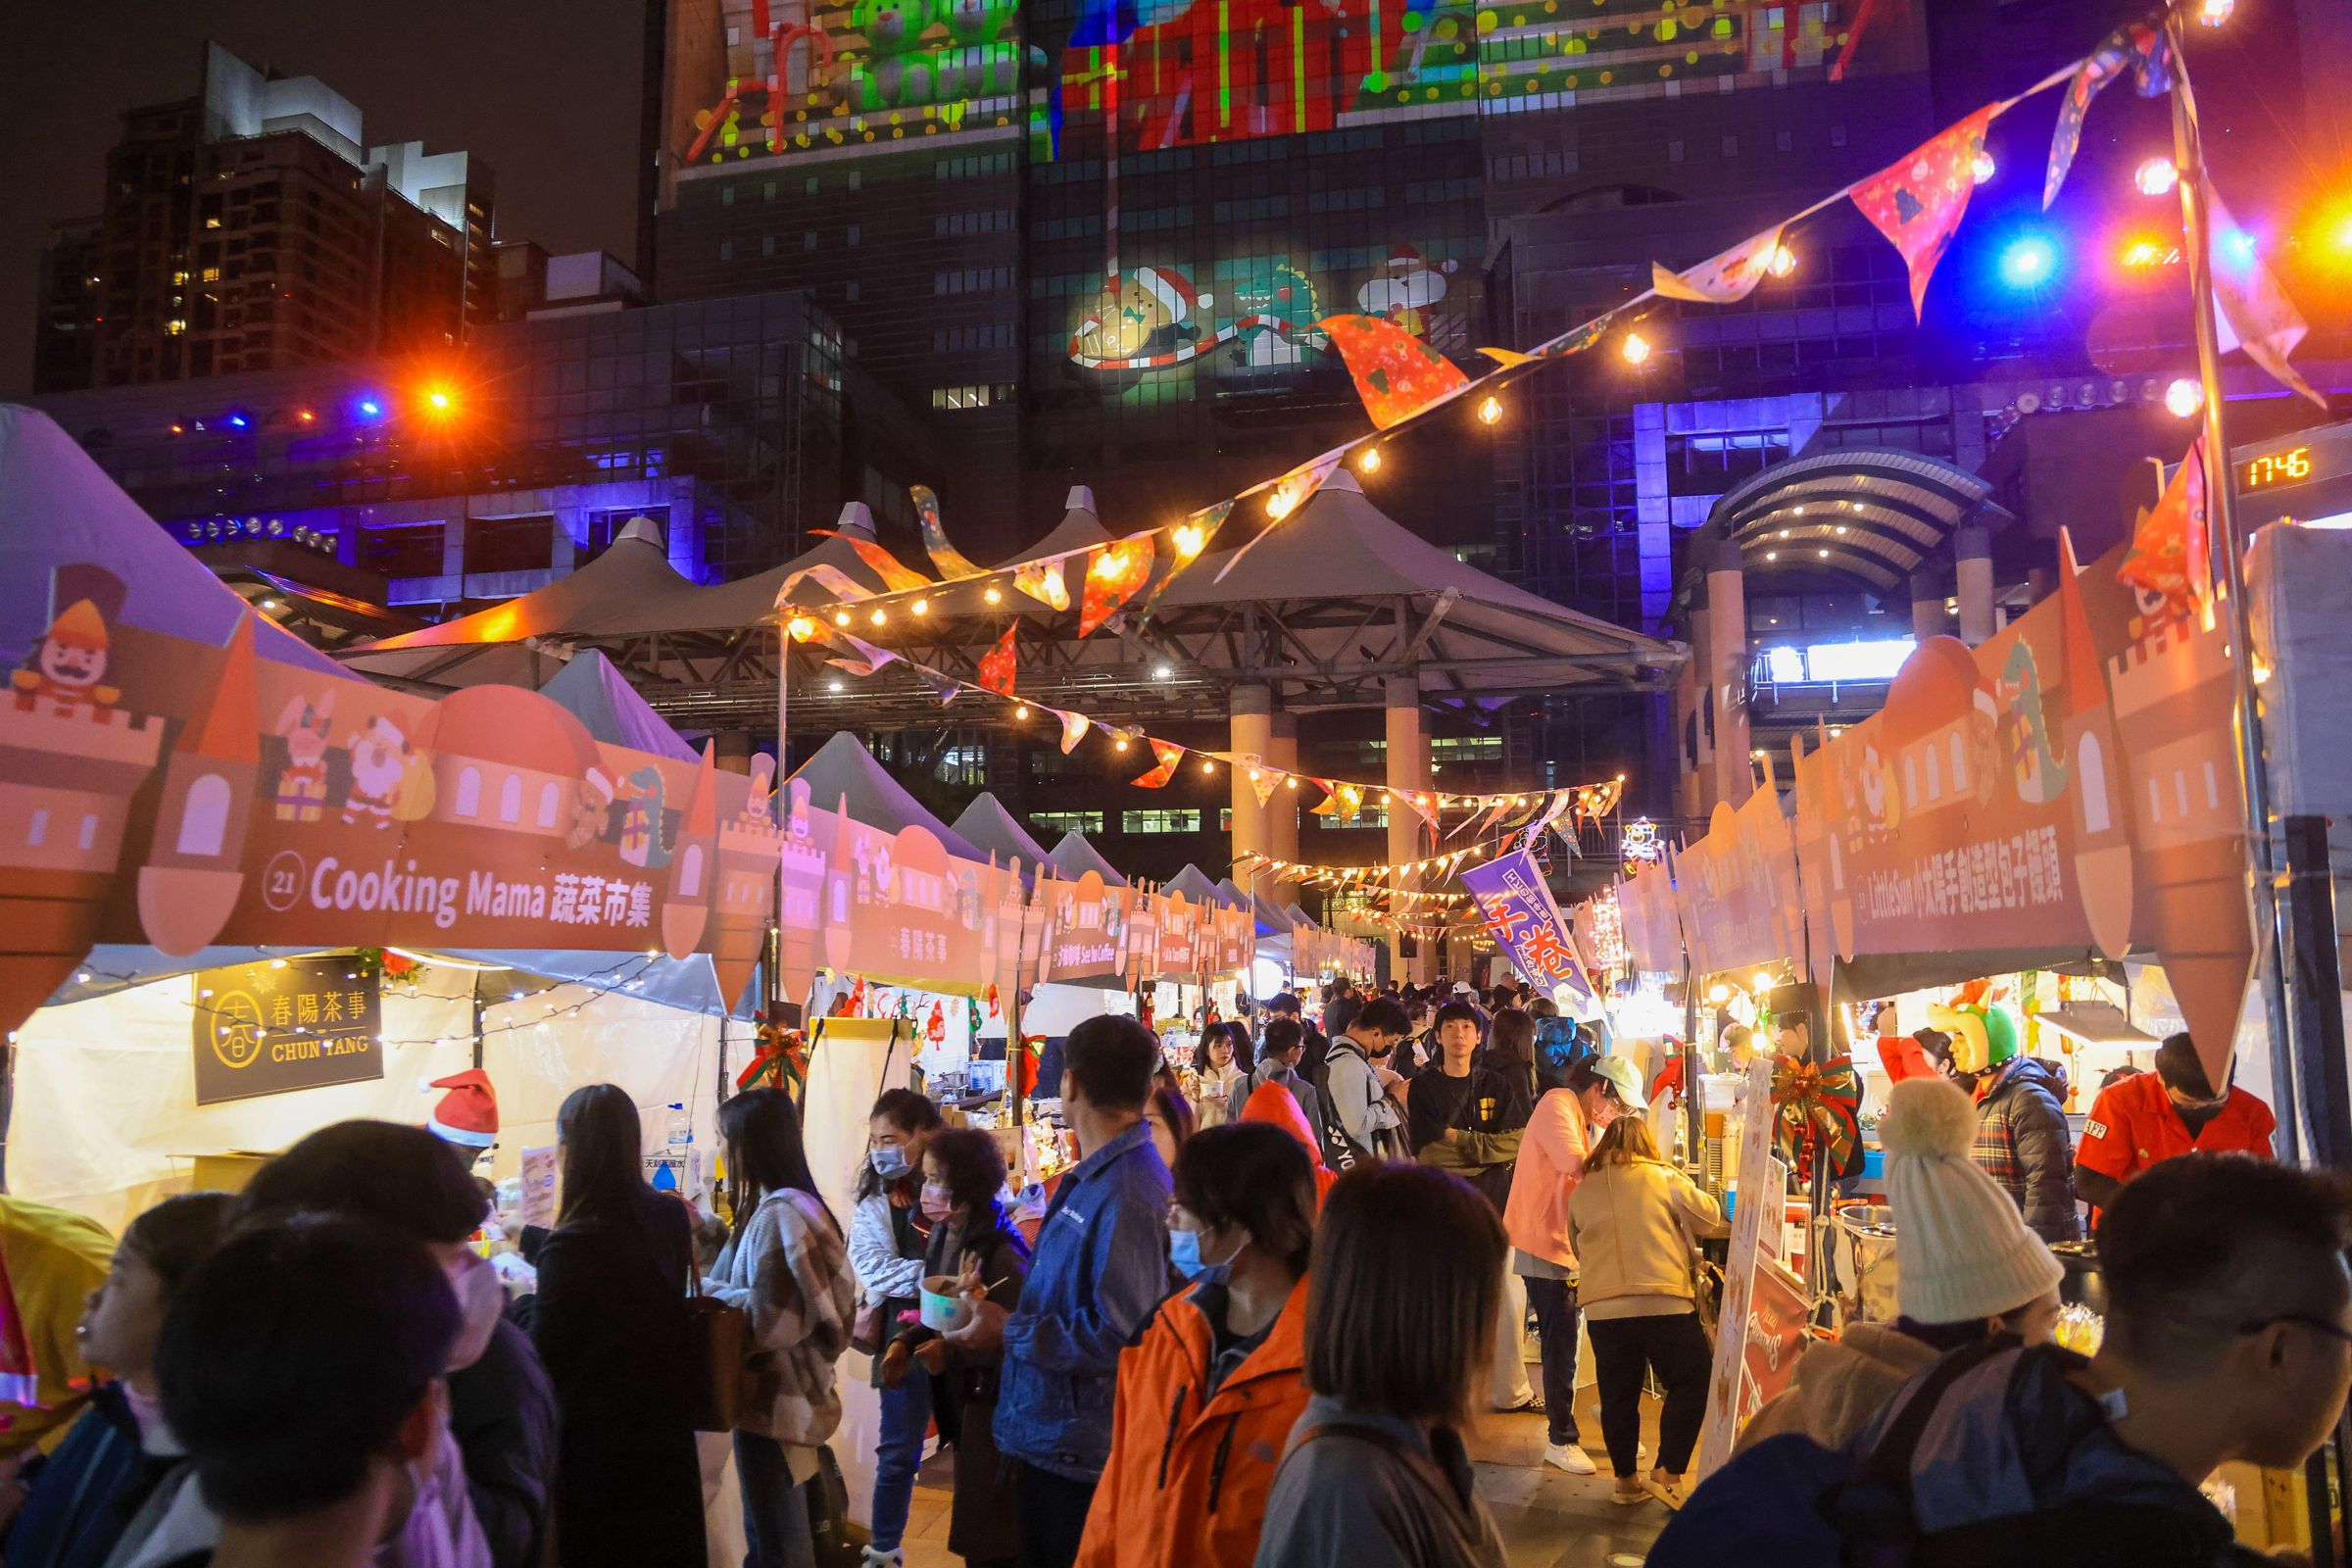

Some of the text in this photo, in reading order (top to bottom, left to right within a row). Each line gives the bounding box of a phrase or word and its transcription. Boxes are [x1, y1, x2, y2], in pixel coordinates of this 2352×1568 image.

[271, 857, 654, 928] 21 Cooking Mama 蔬菜市集
[1868, 869, 1914, 919] LittleSun
[270, 991, 367, 1027] 春陽茶事
[271, 1035, 368, 1062] CHUN YANG
